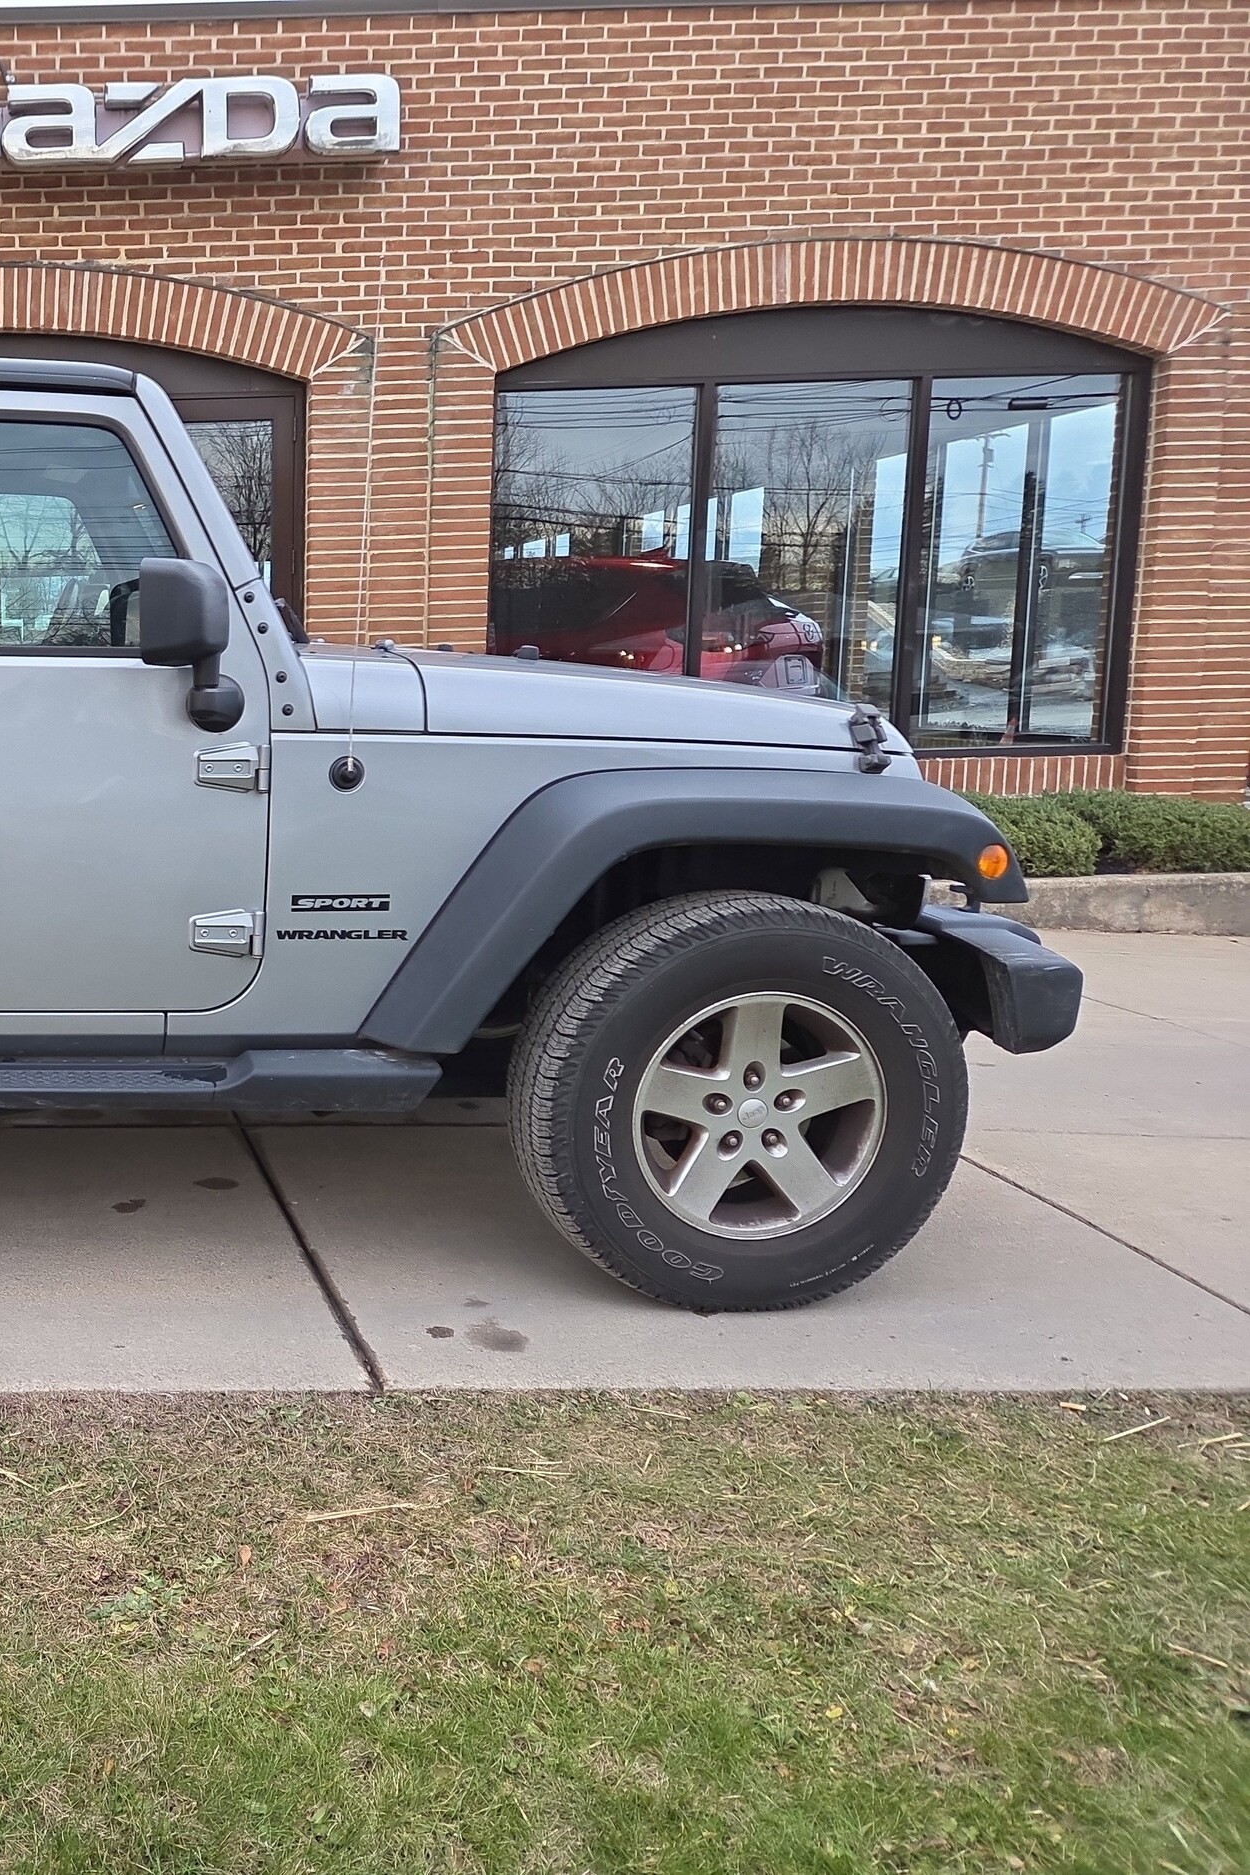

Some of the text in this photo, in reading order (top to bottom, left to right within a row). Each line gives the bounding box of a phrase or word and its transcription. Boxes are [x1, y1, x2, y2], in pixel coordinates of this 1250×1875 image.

[276, 929, 409, 941] WRANGLER
[296, 898, 390, 909] SPORT
[822, 955, 942, 1179] WRANGLER
[590, 1056, 724, 1285] GOODYEAR
